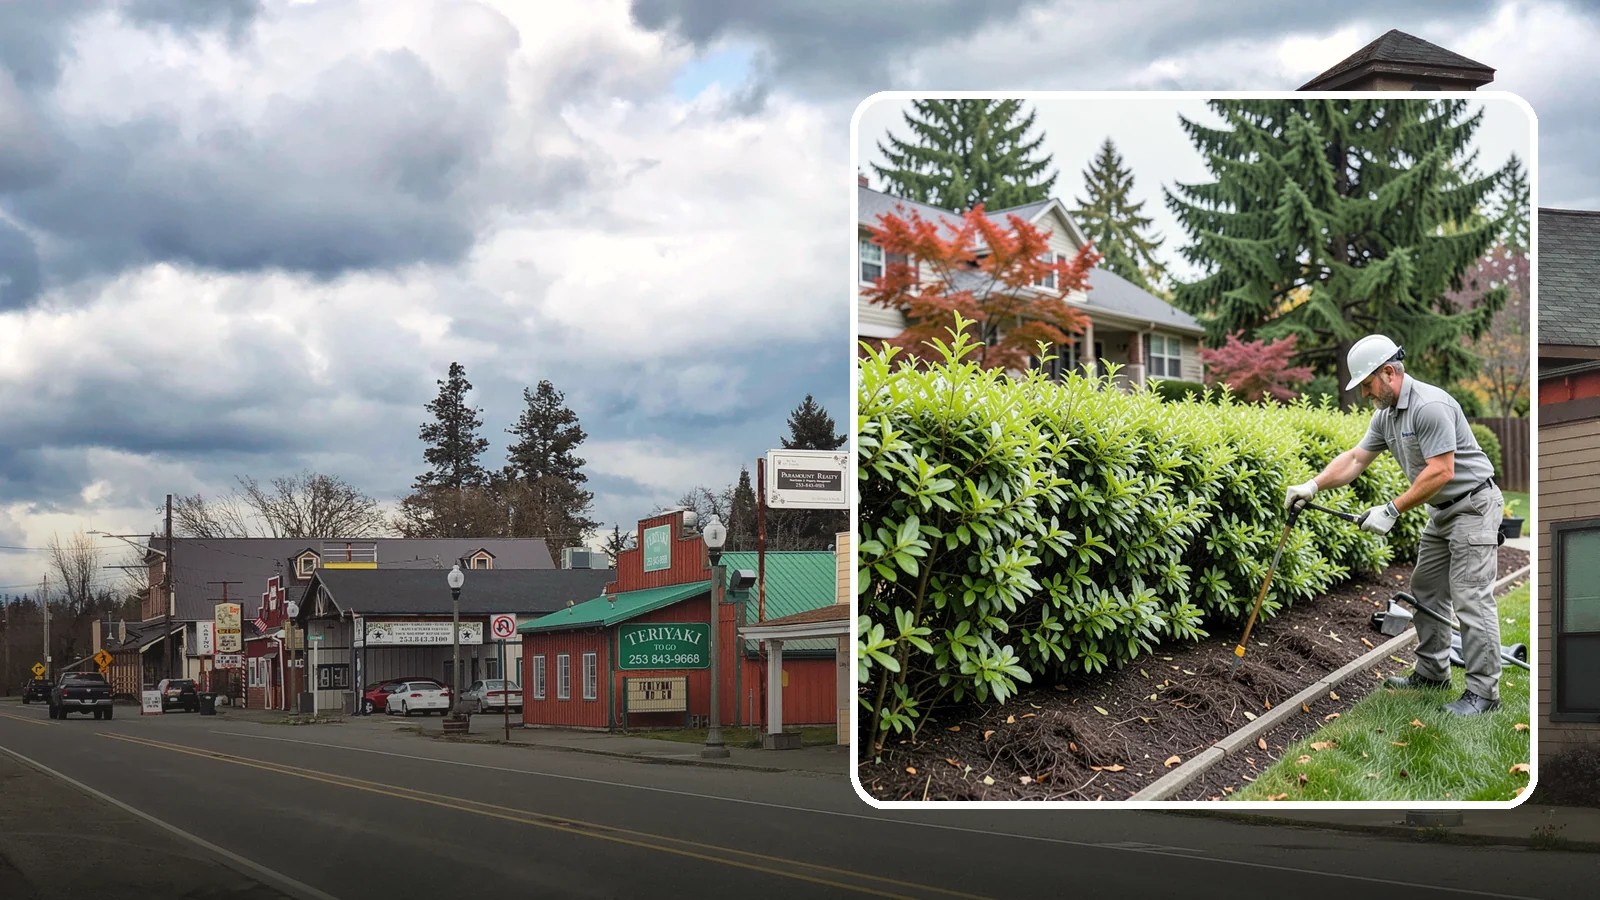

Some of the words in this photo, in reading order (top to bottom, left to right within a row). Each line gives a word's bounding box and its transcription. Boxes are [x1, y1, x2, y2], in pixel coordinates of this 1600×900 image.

[781, 471, 814, 479] PARAMOUNT
[817, 472, 838, 480] REALTY
[229, 606, 240, 614] Roy
[624, 627, 702, 646] TERIYAKI
[628, 654, 648, 664] 253
[652, 654, 700, 664] 843-9668
[639, 681, 672, 690] TERIYAKI
